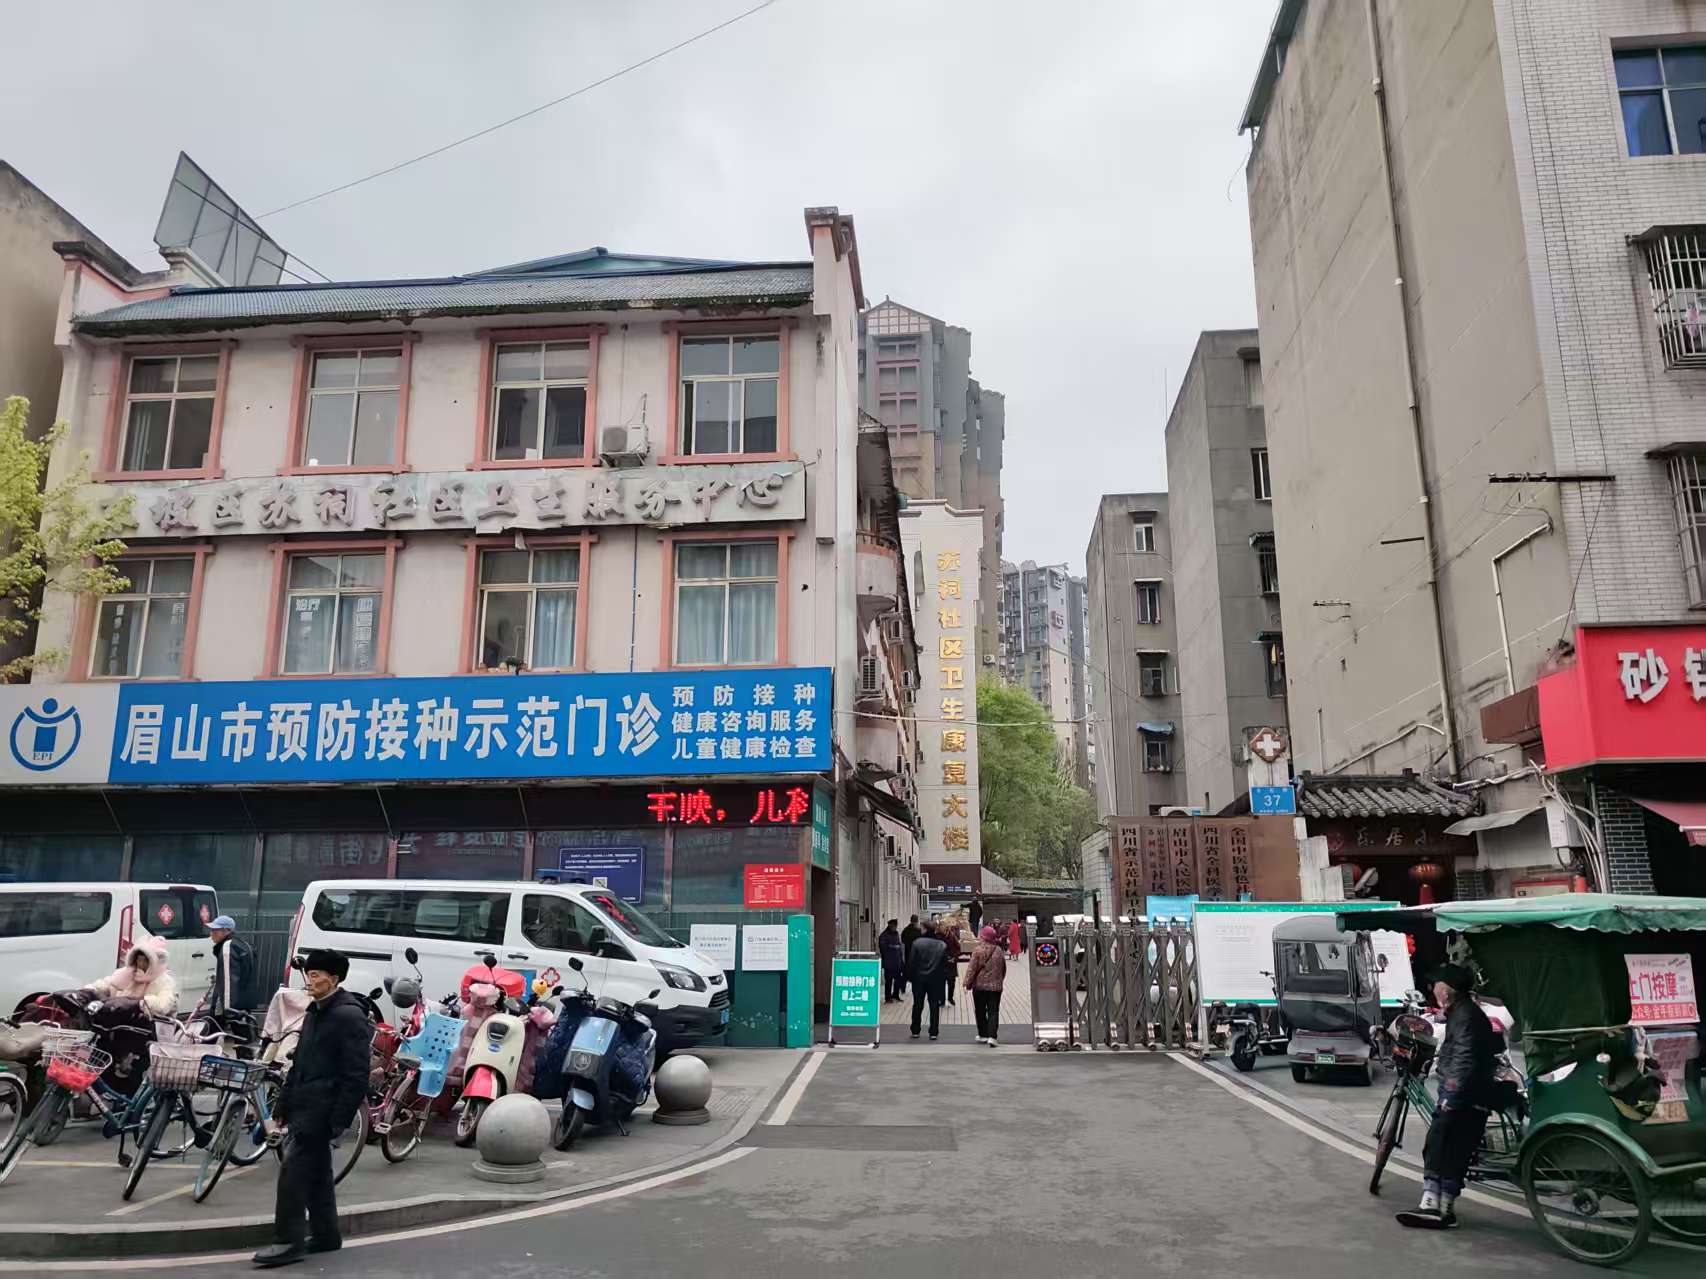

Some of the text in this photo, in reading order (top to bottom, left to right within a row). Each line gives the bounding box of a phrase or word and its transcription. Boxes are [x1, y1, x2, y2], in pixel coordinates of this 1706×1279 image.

[672, 683, 816, 706] 预防接种
[120, 692, 662, 765] 眉山市预防接种示范门诊
[672, 709, 817, 734] 健康咨询服务
[33, 751, 53, 761] EPI
[672, 735, 817, 760] 儿童健康检查
[1264, 795, 1281, 807] 37
[1204, 827, 1222, 902] 四川省全科医学
